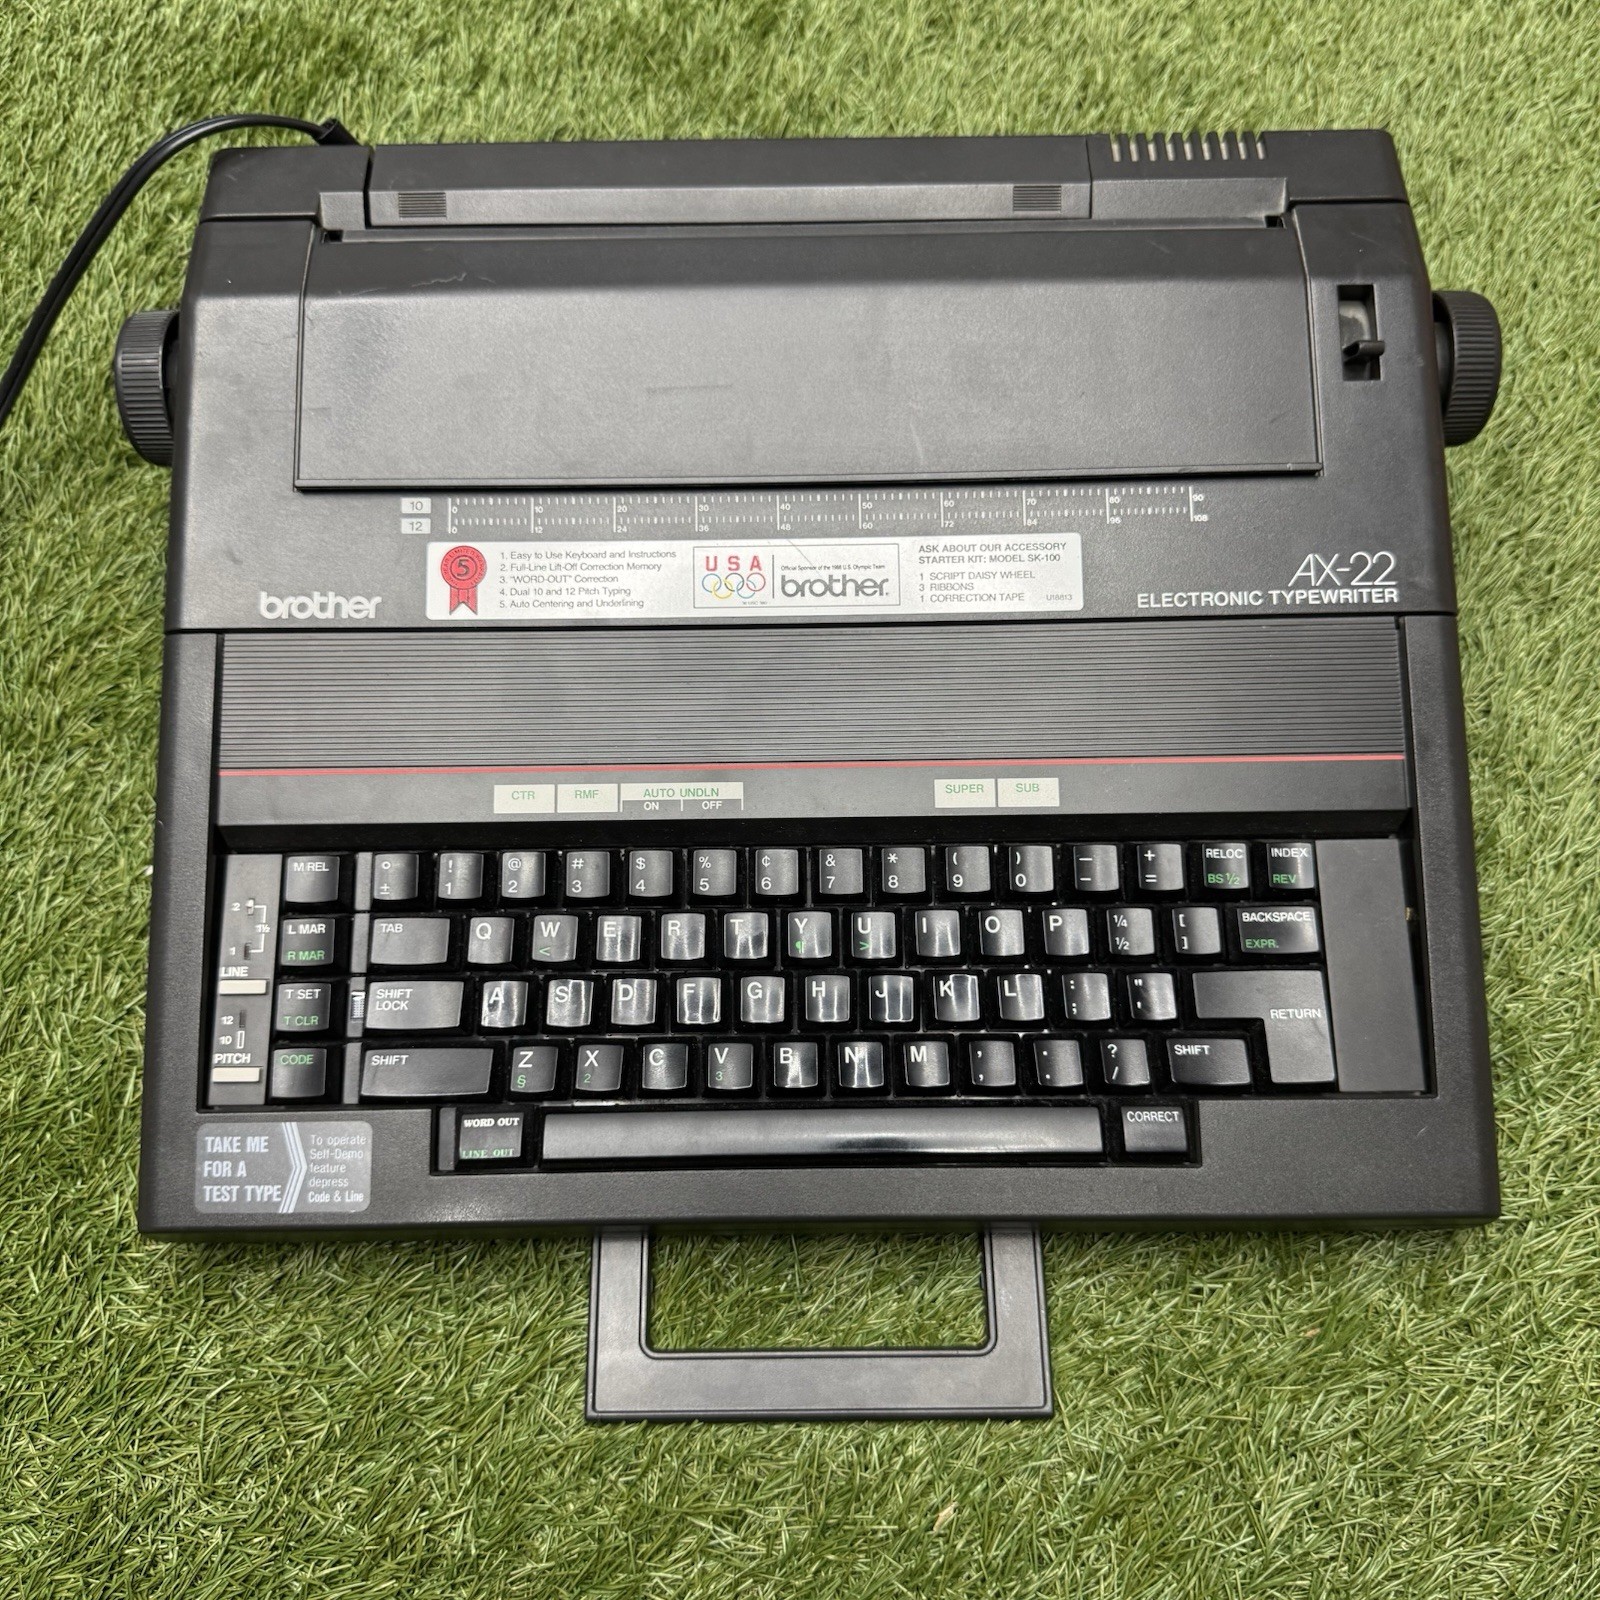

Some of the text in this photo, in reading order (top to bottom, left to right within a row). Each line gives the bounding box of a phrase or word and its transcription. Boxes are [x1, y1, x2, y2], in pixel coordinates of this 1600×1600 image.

[410, 502, 422, 510] 10
[410, 522, 422, 531] 12
[919, 542, 1066, 553] ASK ABOUT OUR ACCESSORY
[511, 552, 531, 560] Easy
[566, 551, 606, 560] Keyboard
[919, 554, 1060, 564] STARTER KIT: MODEL SK-100
[457, 559, 470, 576] 5
[550, 563, 577, 571] Lift-Off
[627, 563, 662, 572] Memory
[1288, 551, 1398, 587] AX-22
[930, 572, 966, 580] SCRIPT
[968, 572, 998, 580] DAISY
[1000, 570, 1035, 579] WHEEL
[602, 587, 631, 596] Typing
[919, 582, 974, 592] 3 RIBBONS
[930, 594, 996, 602] CORRECTION
[1000, 593, 1024, 601] TAPE
[1138, 588, 1398, 608] ELECTRONIC TYPEWRITER
[260, 591, 382, 619] brother
[533, 600, 574, 609] Centering
[596, 599, 644, 609] Underlining
[946, 784, 984, 793] SUPER
[1016, 783, 1040, 792] SUB
[512, 790, 535, 800] CTR
[575, 790, 599, 798] RMF
[644, 788, 718, 798] AUTO UNDLN
[644, 802, 659, 810] ON
[702, 801, 722, 810] OFF
[1206, 848, 1242, 859] RELOC
[1271, 848, 1308, 858] INDEX
[294, 862, 329, 871] M REL
[1208, 874, 1223, 884] BS
[1273, 874, 1296, 884] REV
[232, 903, 240, 911] 2
[1242, 912, 1311, 922] BACKSPACE
[288, 924, 326, 934] L MAR
[381, 924, 403, 932] TAB
[604, 922, 616, 936] E
[668, 921, 681, 936] R
[730, 920, 744, 935] T
[794, 918, 809, 934] Y
[858, 918, 871, 934] U
[984, 917, 1000, 933] O
[1049, 916, 1062, 932] P
[476, 923, 492, 940] Q
[541, 922, 560, 937] W
[1246, 939, 1279, 949] EXPR.
[288, 950, 324, 960] R MAR
[221, 967, 248, 976] LINE
[620, 985, 633, 1000] D
[684, 984, 695, 999] F
[748, 982, 762, 999] G
[812, 982, 825, 997] H
[1004, 980, 1016, 996] L
[286, 989, 320, 999] T SET
[376, 989, 412, 999] SHIFT
[555, 987, 570, 1002] S
[375, 1000, 408, 1010] LOCK
[1270, 1008, 1321, 1019] RETURN
[222, 1016, 234, 1024] 12
[284, 1016, 318, 1025] T CLR
[220, 1036, 232, 1044] 10
[910, 1046, 926, 1062] M
[1174, 1044, 1210, 1055] SHIFT
[214, 1054, 250, 1063] PITCH
[280, 1055, 314, 1064] CODE
[372, 1055, 408, 1065] SHIFT
[519, 1052, 532, 1067] Z
[585, 1050, 599, 1066] X
[649, 1048, 664, 1066] C
[715, 1048, 729, 1064] V
[780, 1048, 792, 1064] B
[1127, 1111, 1178, 1122] CORRECT
[464, 1118, 519, 1128] WORD OUT
[206, 1136, 268, 1152] TAKE ME
[311, 1134, 366, 1146] To operate
[310, 1149, 363, 1160] Self-Demo
[462, 1148, 514, 1158] LINE OUT
[204, 1160, 246, 1178] FOR A
[310, 1163, 346, 1173] feature
[309, 1176, 348, 1188] depress
[203, 1185, 282, 1202] TEST TYPE
[308, 1190, 364, 1202] Code & Line
